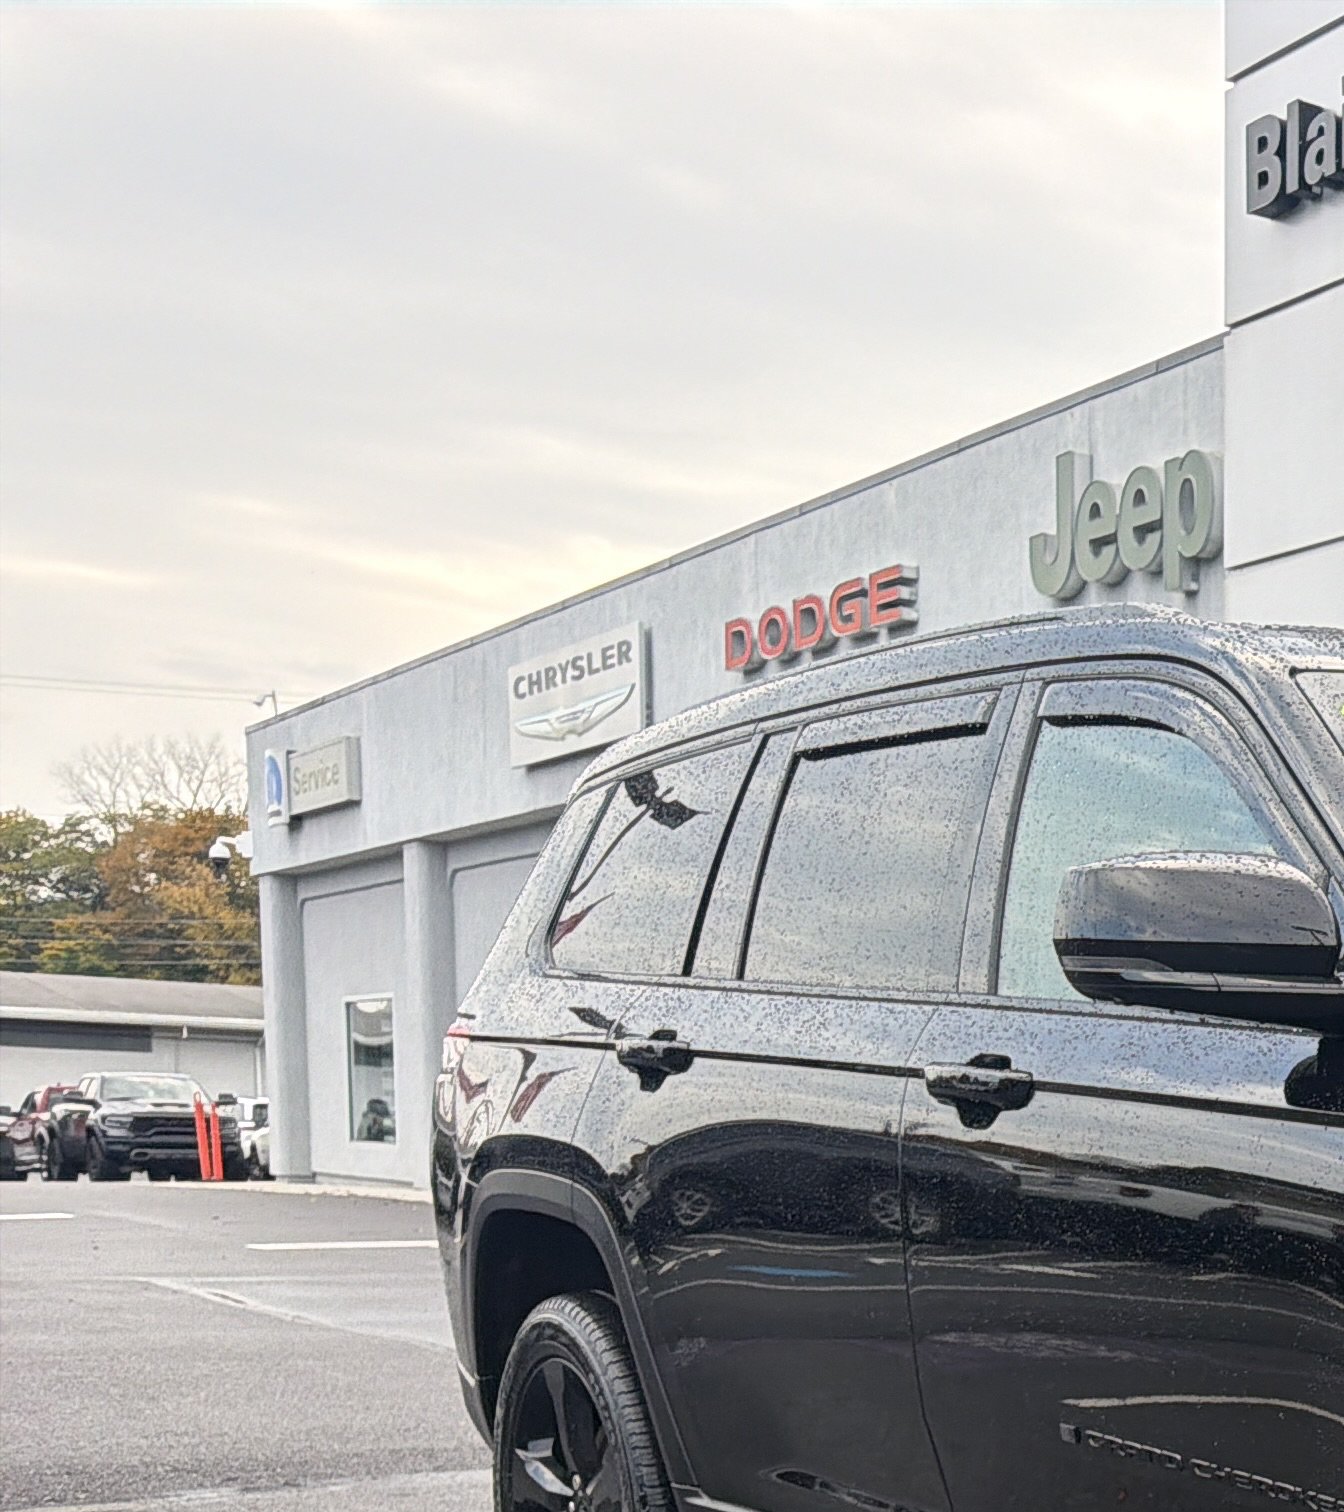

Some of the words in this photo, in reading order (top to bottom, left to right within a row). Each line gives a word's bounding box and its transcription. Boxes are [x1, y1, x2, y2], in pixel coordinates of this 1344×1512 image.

[1029, 449, 1222, 600] Jeep
[725, 563, 912, 671] DODGE
[513, 639, 633, 700] CHRYSLER
[293, 759, 340, 796] Service
